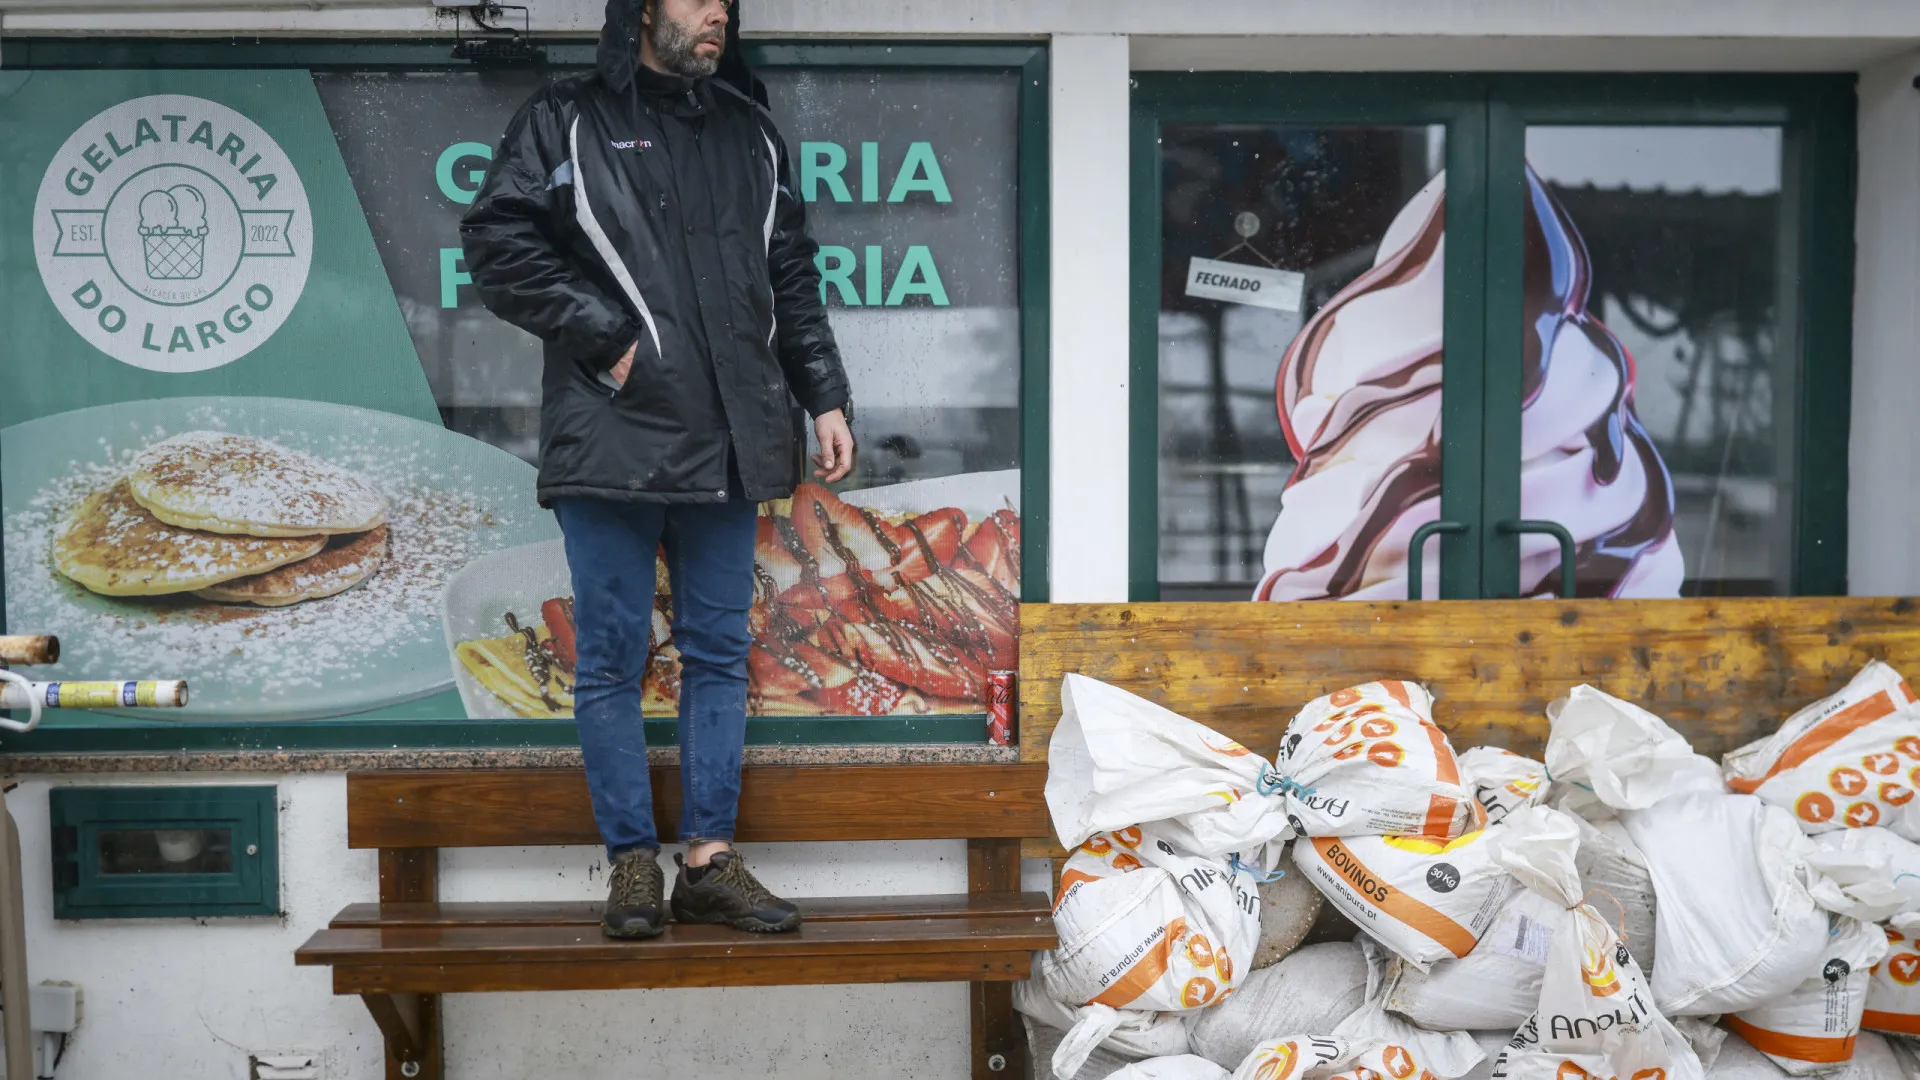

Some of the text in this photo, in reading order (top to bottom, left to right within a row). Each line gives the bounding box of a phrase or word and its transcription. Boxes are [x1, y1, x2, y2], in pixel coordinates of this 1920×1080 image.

[64, 114, 279, 201] GELATARIA
[71, 224, 97, 242] EST.
[251, 225, 279, 243] 2022
[1195, 271, 1262, 292] FECHADO
[71, 278, 274, 353] DO LARGO
[1316, 864, 1378, 921] www.anipura.pt
[1326, 844, 1389, 903] BOVINOS
[1430, 867, 1457, 888] 30 Kg
[1098, 925, 1166, 988] www.anipura.pt
